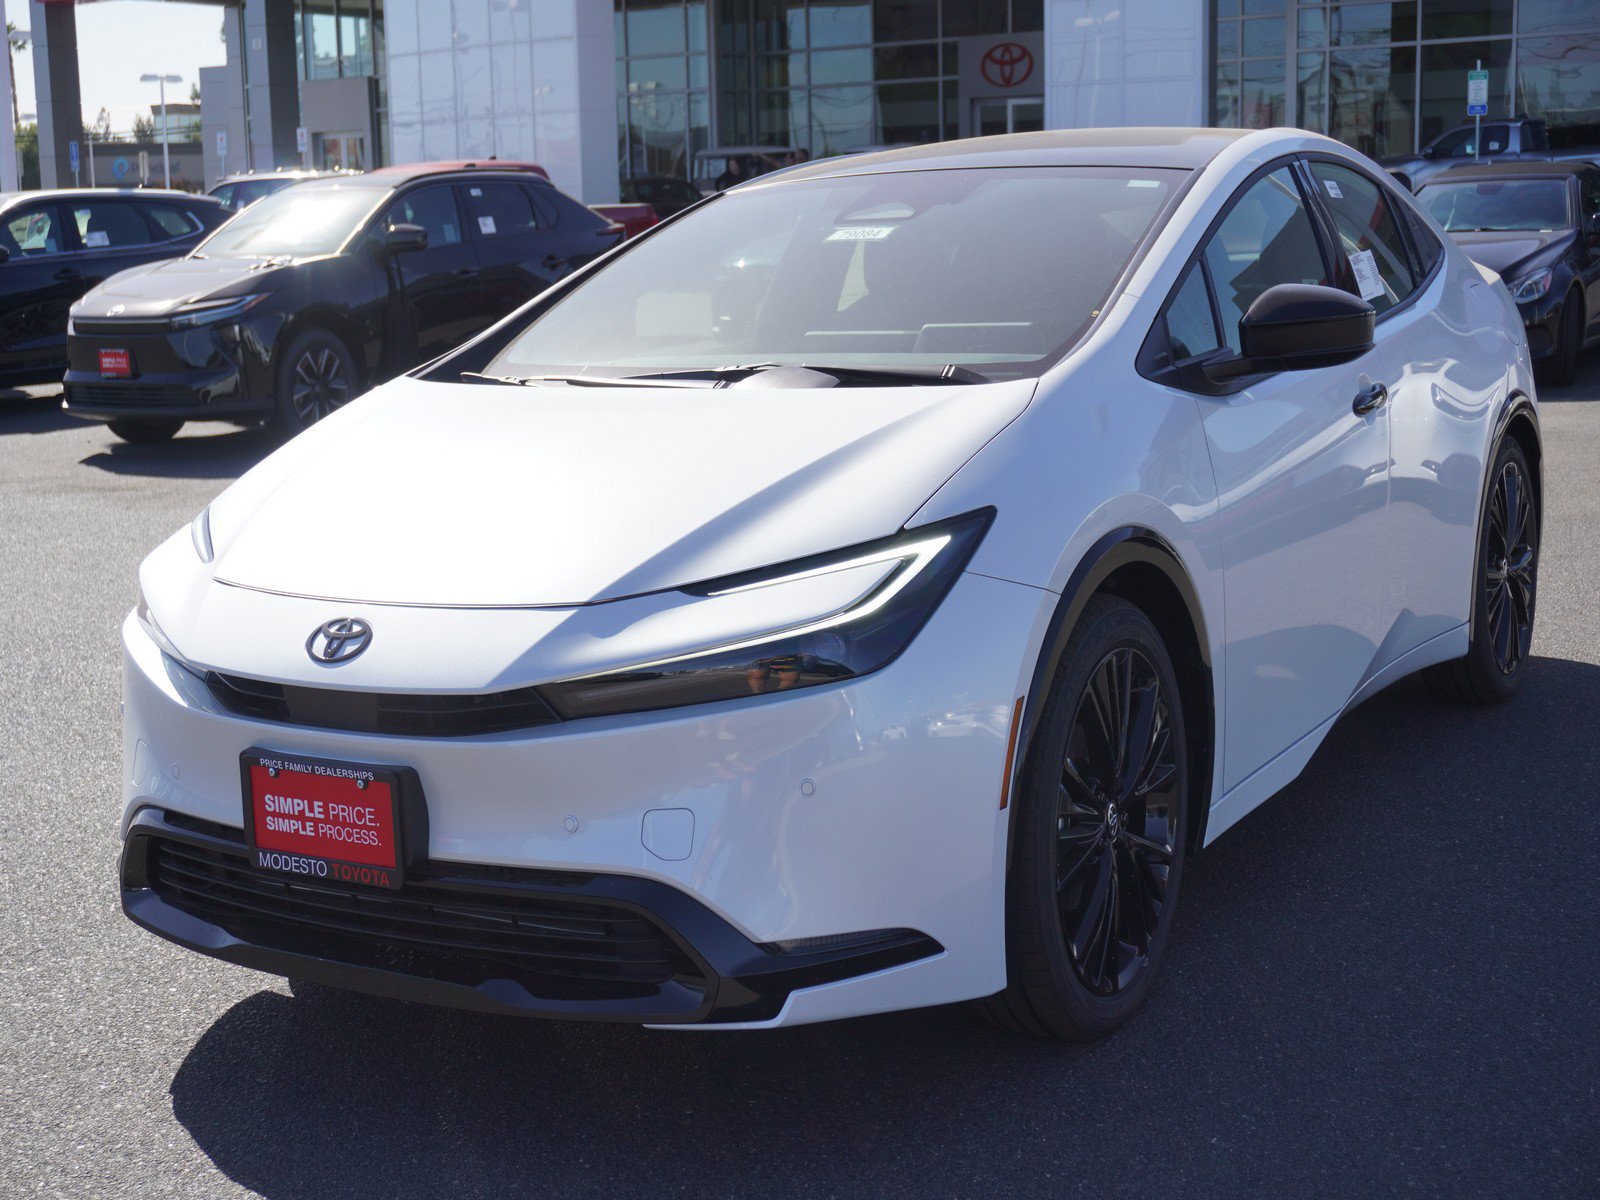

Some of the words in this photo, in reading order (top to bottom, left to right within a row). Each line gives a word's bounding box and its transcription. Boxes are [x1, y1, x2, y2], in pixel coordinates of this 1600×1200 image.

[259, 758, 283, 770] PRICE
[284, 761, 312, 774] FAMILY
[314, 765, 374, 781] DEALERSHIPS
[264, 794, 325, 819] SIMPLE
[328, 803, 380, 827] PRICE.
[266, 816, 315, 836] SIMPLE
[318, 823, 382, 846] PROCESS.
[258, 852, 328, 877] MODESTO
[331, 863, 390, 887] TOYOTA
